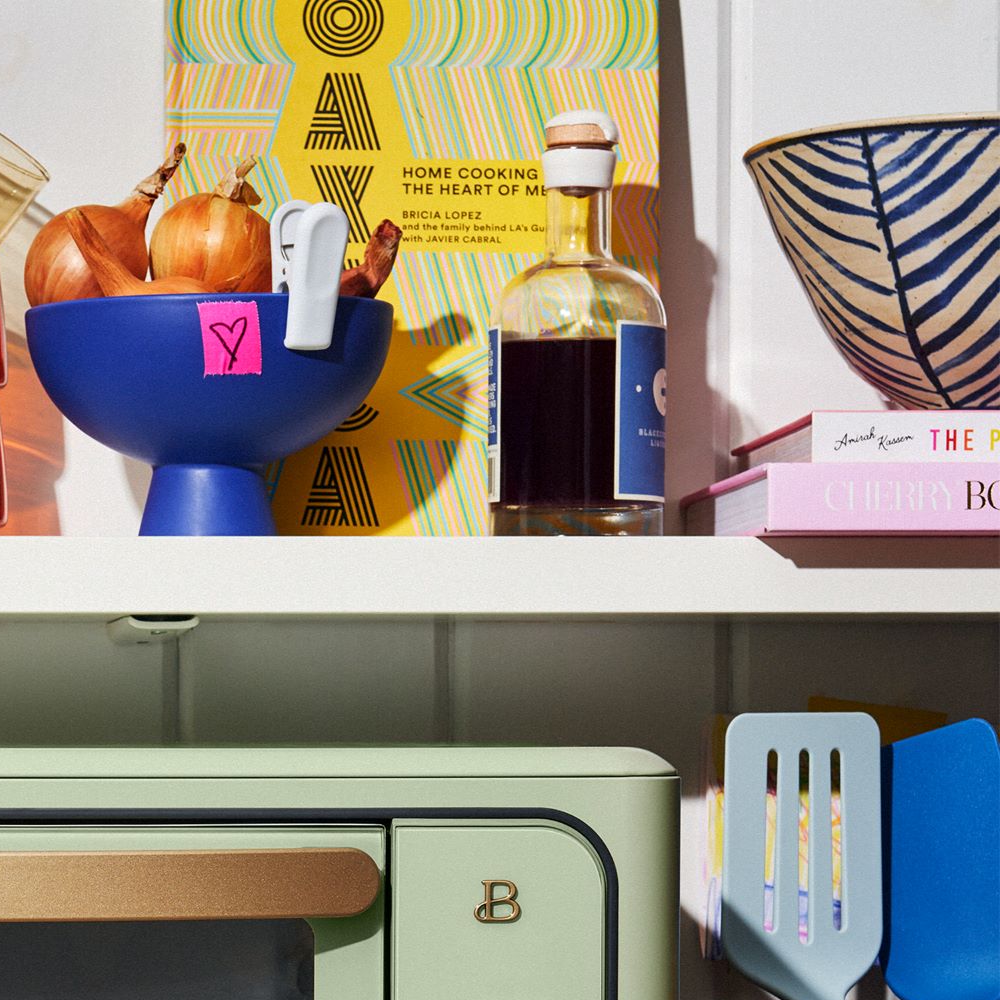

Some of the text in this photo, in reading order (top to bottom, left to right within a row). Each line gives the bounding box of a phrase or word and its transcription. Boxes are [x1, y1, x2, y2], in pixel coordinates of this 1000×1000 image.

[402, 167, 538, 180] HOME COOKING
[402, 183, 434, 195] THE
[440, 184, 493, 196] HEART
[498, 184, 520, 196] OF
[402, 210, 482, 220] BRICIA LOPEZ
[402, 223, 420, 231] and
[423, 223, 438, 231] the
[441, 223, 471, 233] family
[473, 224, 506, 232] behind
[509, 224, 528, 232] LA's
[402, 235, 502, 244] with JAVIER CABRAL
[834, 426, 876, 451] Amirah
[877, 435, 915, 451] Kassem
[929, 429, 1000, 451] THE P
[824, 480, 956, 513] CHERRY
